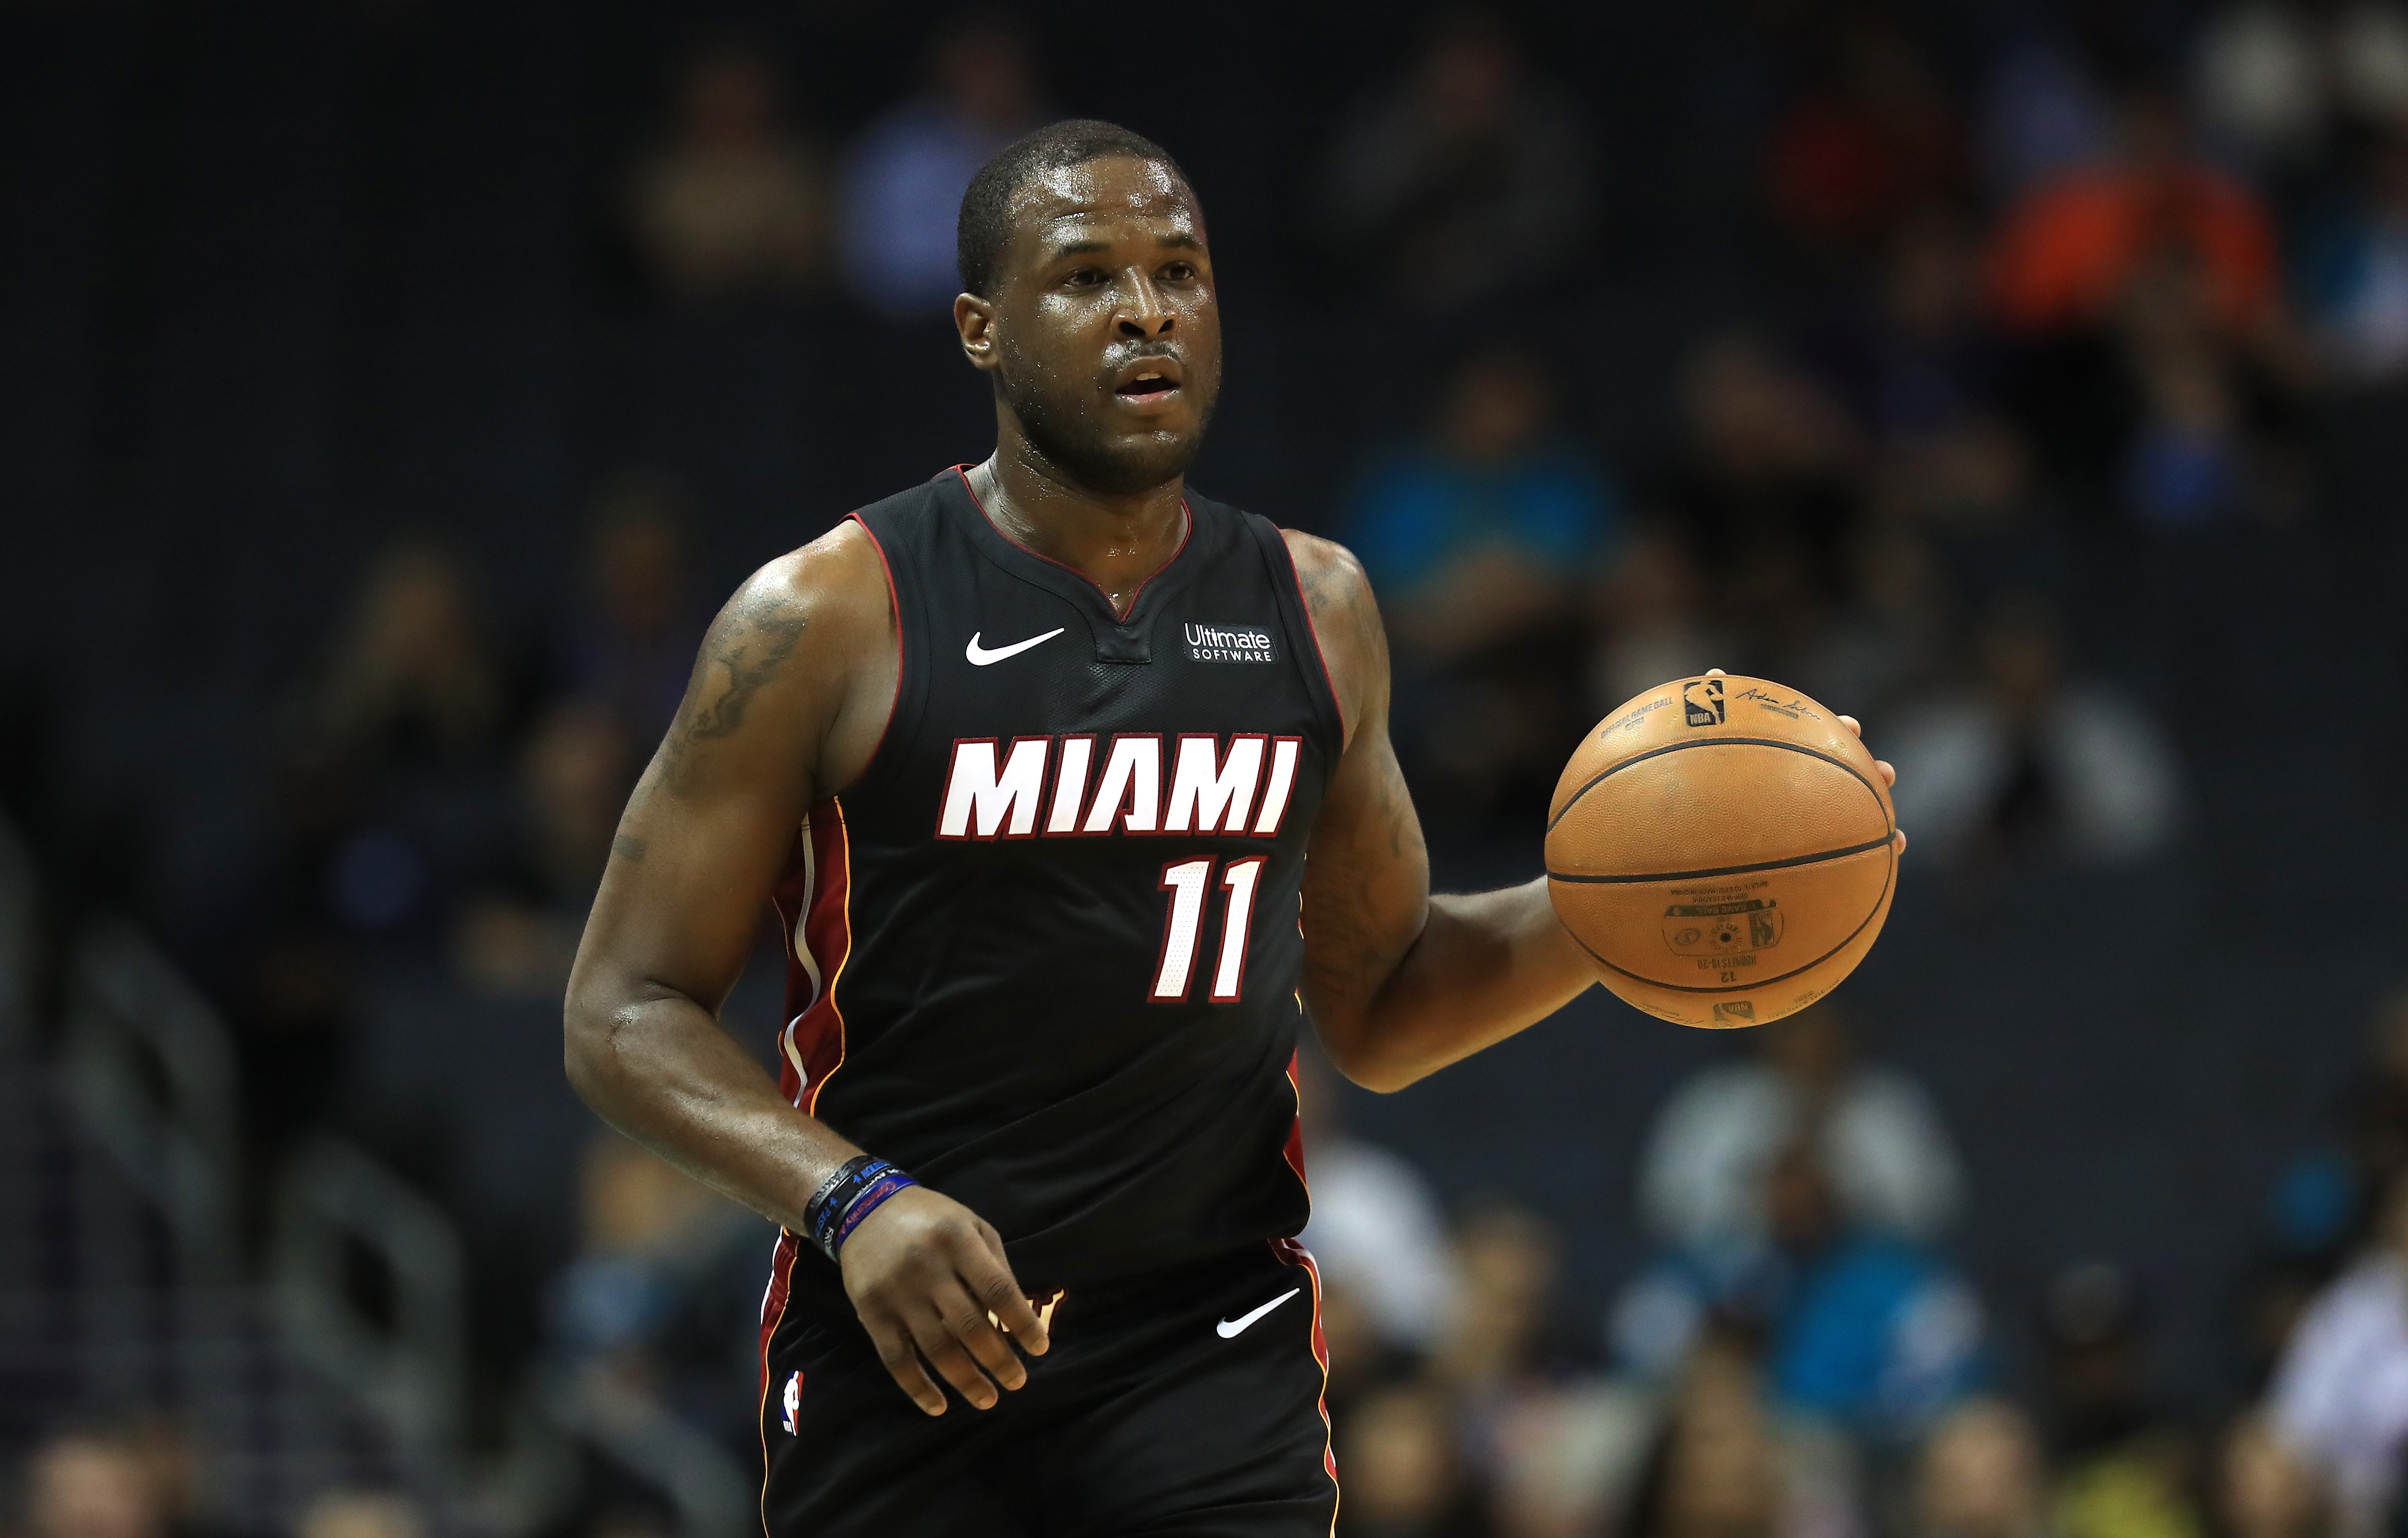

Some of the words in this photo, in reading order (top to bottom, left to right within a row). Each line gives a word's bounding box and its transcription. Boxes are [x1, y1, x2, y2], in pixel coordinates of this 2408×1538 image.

[1185, 623, 1271, 649] Ultimate
[1192, 648, 1272, 662] SOFTWARE
[1654, 697, 1673, 710] BALL
[1690, 712, 1711, 725] NBA
[934, 733, 1302, 840] MIAMI
[1147, 854, 1268, 1003] 11
[1720, 971, 1737, 983] 12
[1728, 1003, 1748, 1011] NBA
